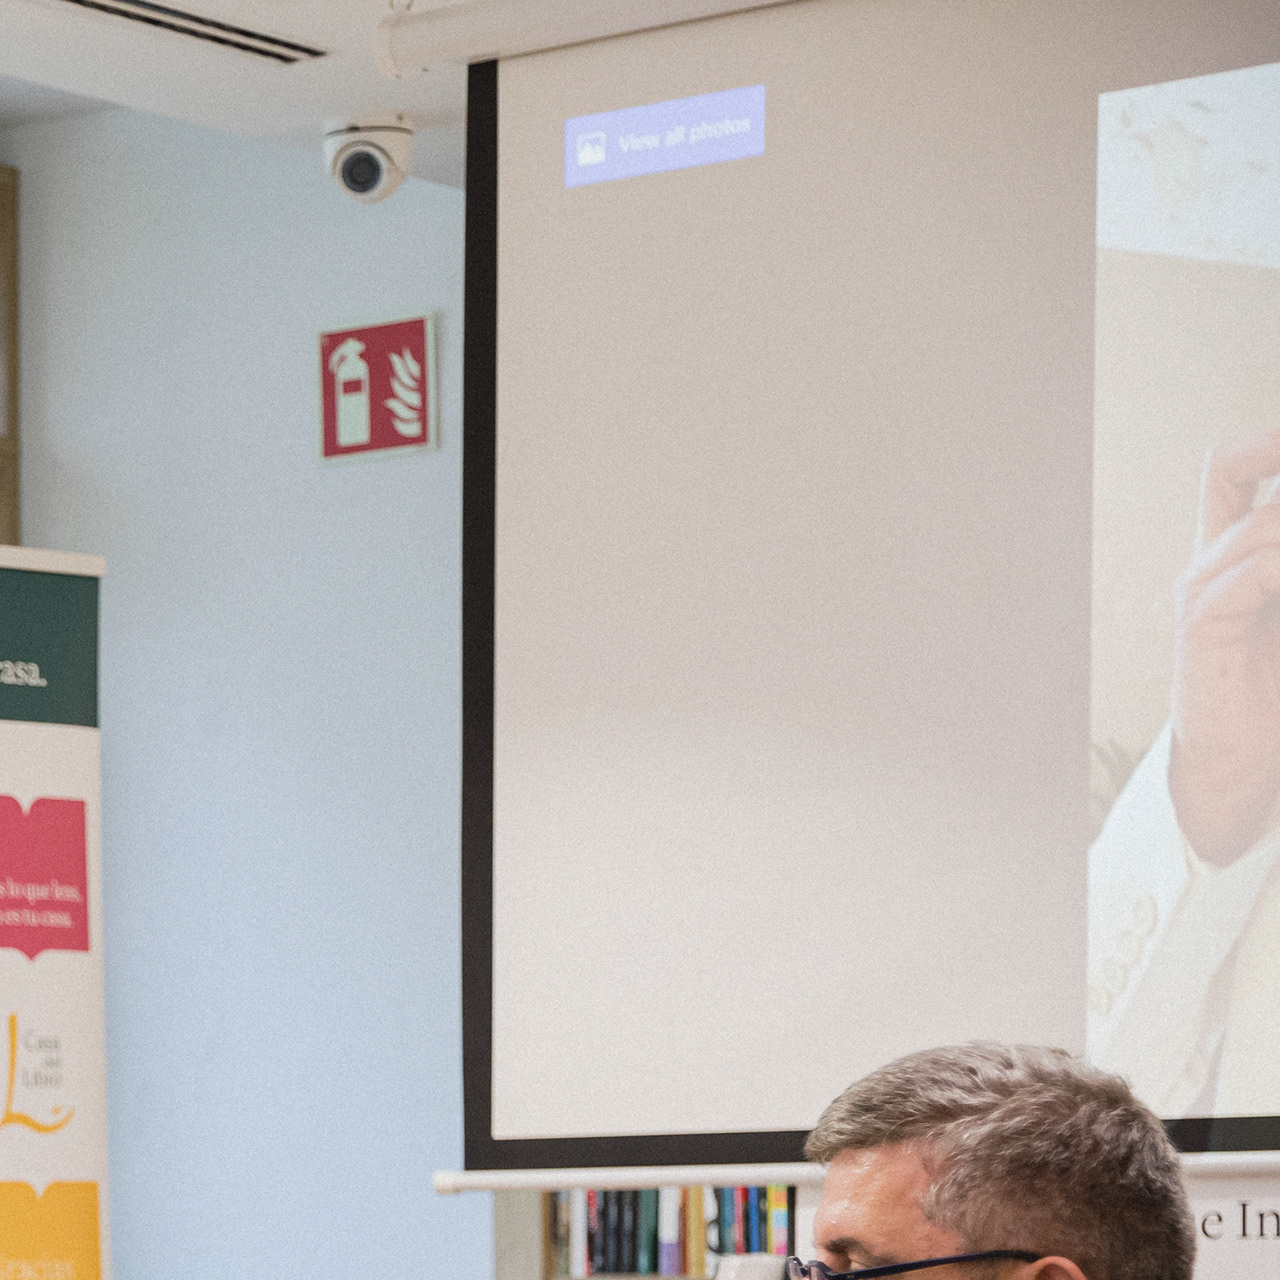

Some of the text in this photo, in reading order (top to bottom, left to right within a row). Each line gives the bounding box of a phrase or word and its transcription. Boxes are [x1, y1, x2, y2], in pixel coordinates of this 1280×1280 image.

[618, 118, 752, 152] View all photos
